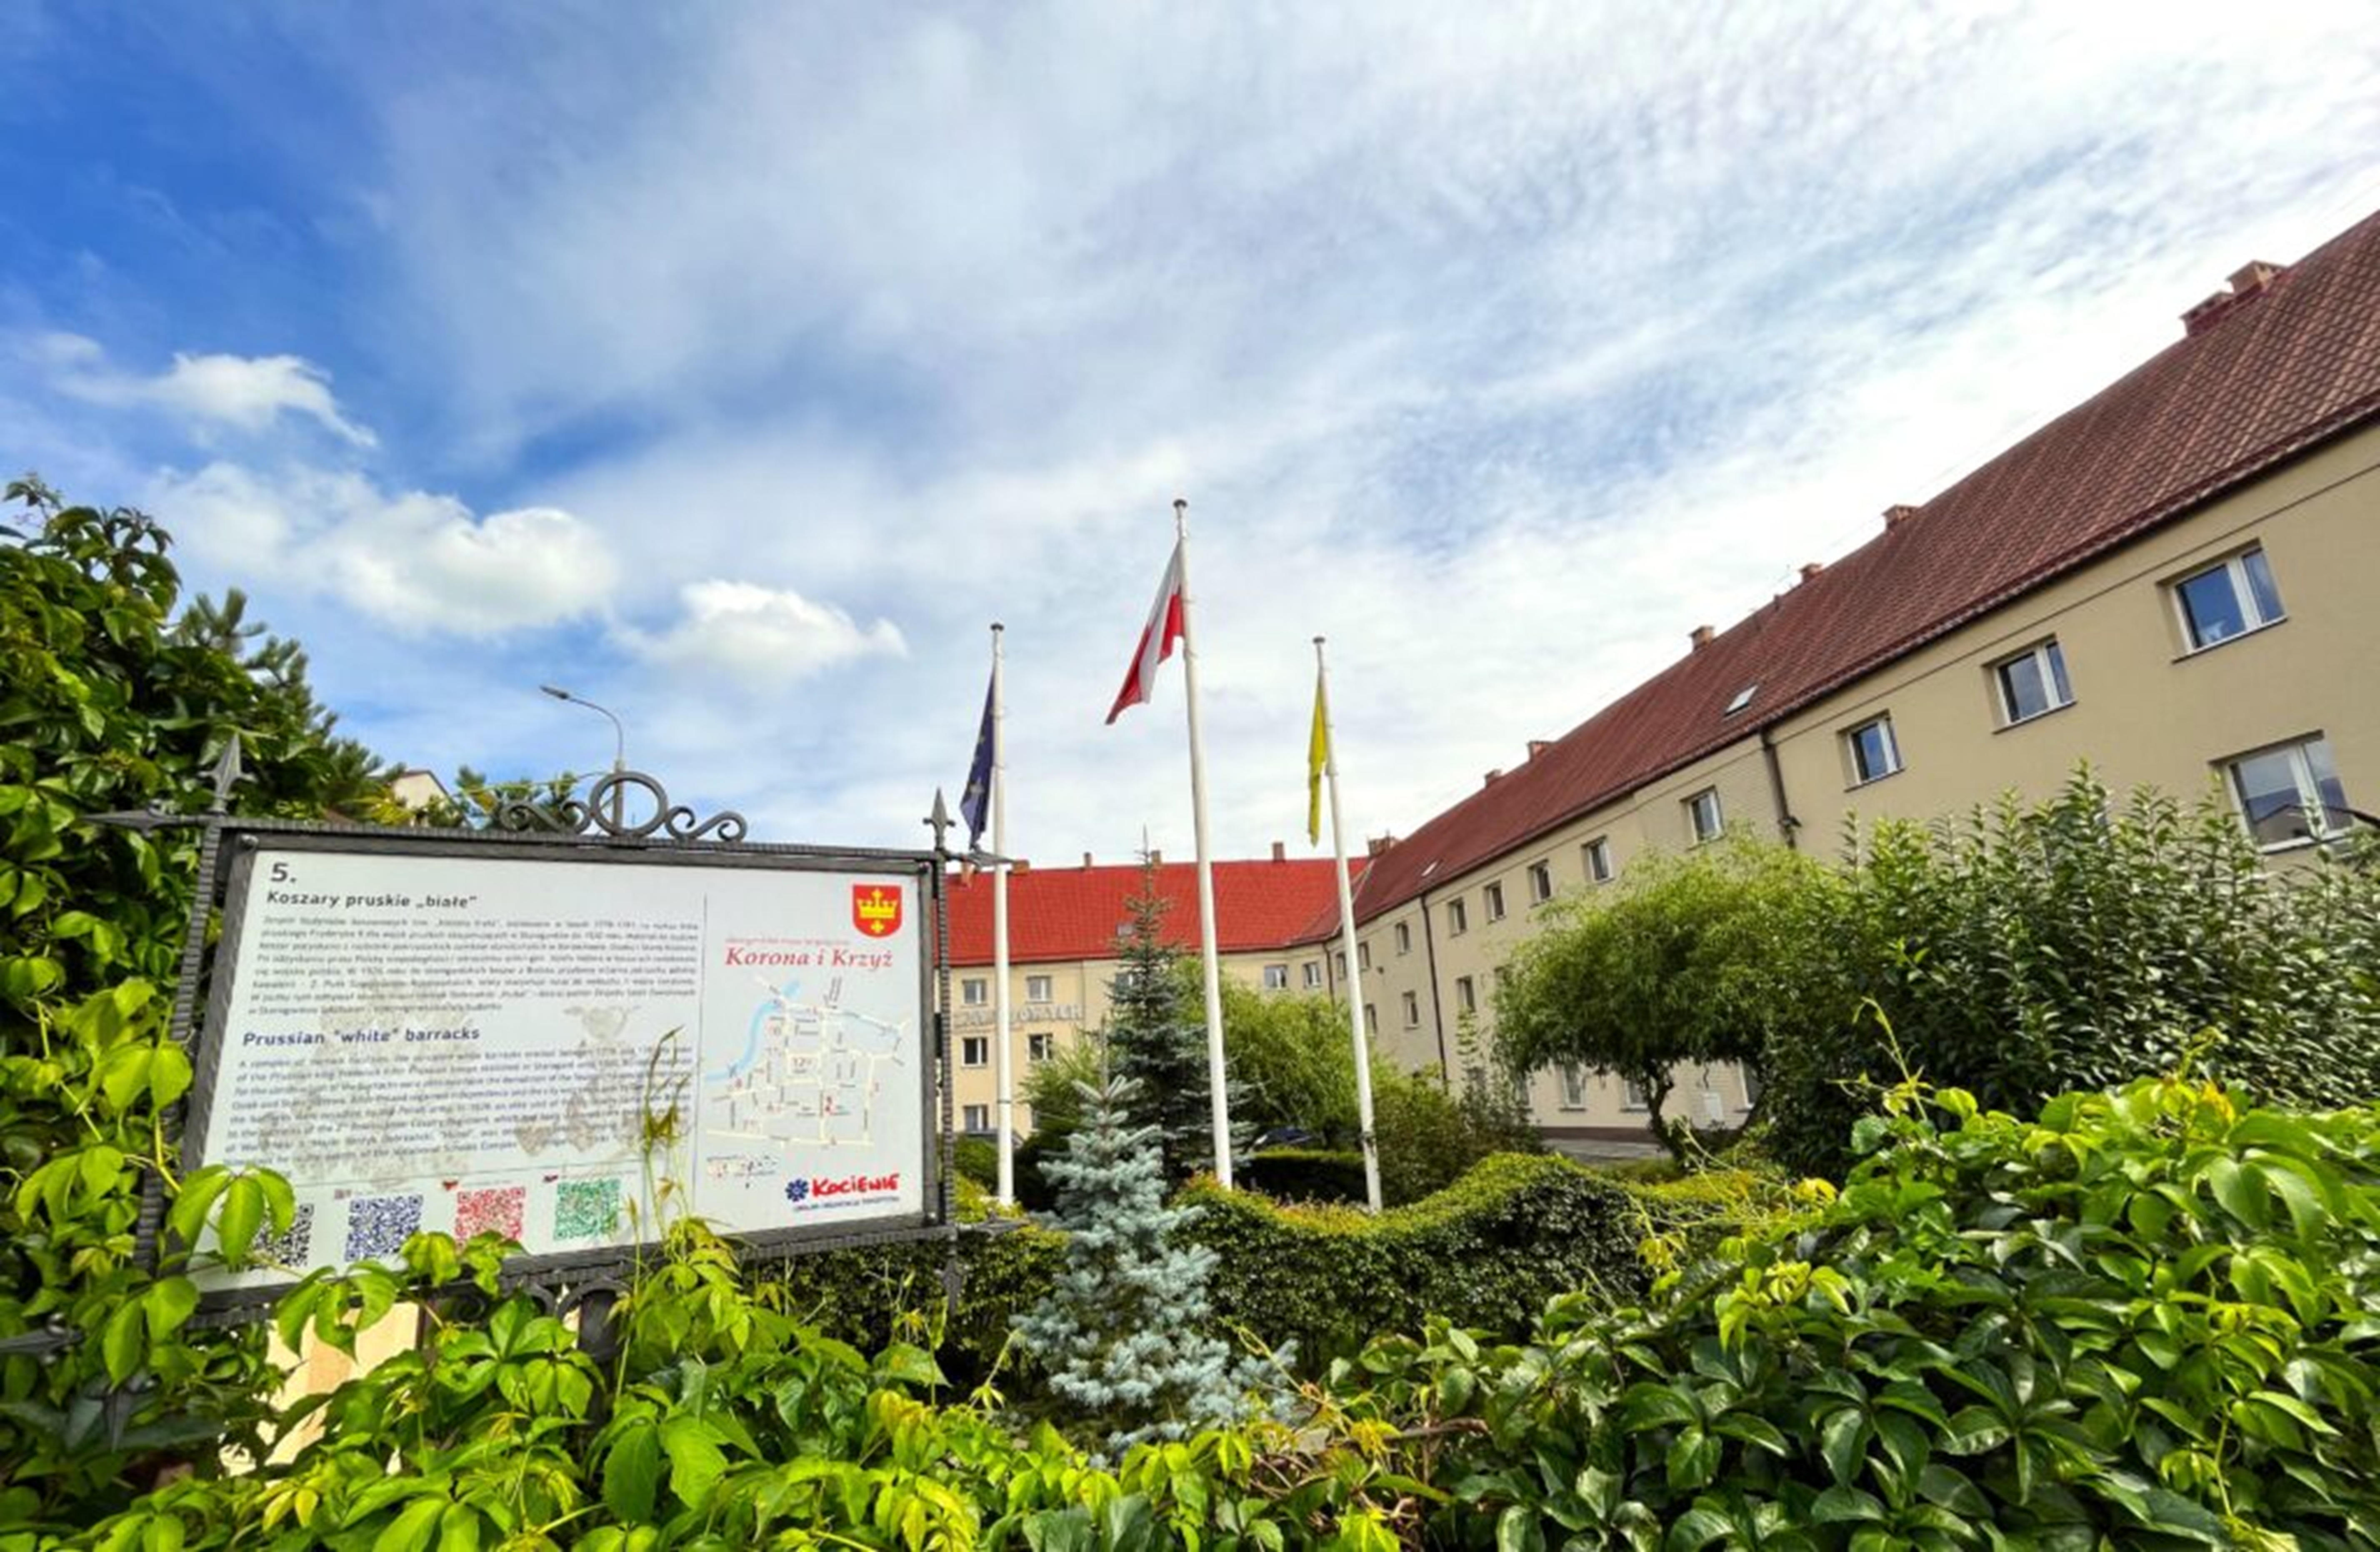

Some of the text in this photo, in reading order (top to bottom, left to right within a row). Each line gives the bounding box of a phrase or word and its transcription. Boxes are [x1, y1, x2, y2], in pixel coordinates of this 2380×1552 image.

[270, 862, 297, 883] 5.
[267, 891, 340, 908] Koszary
[345, 892, 410, 908] pruskie
[725, 947, 893, 972] Korona i Krzyż
[243, 1031, 325, 1047] Prussian
[405, 1027, 480, 1042] barracks
